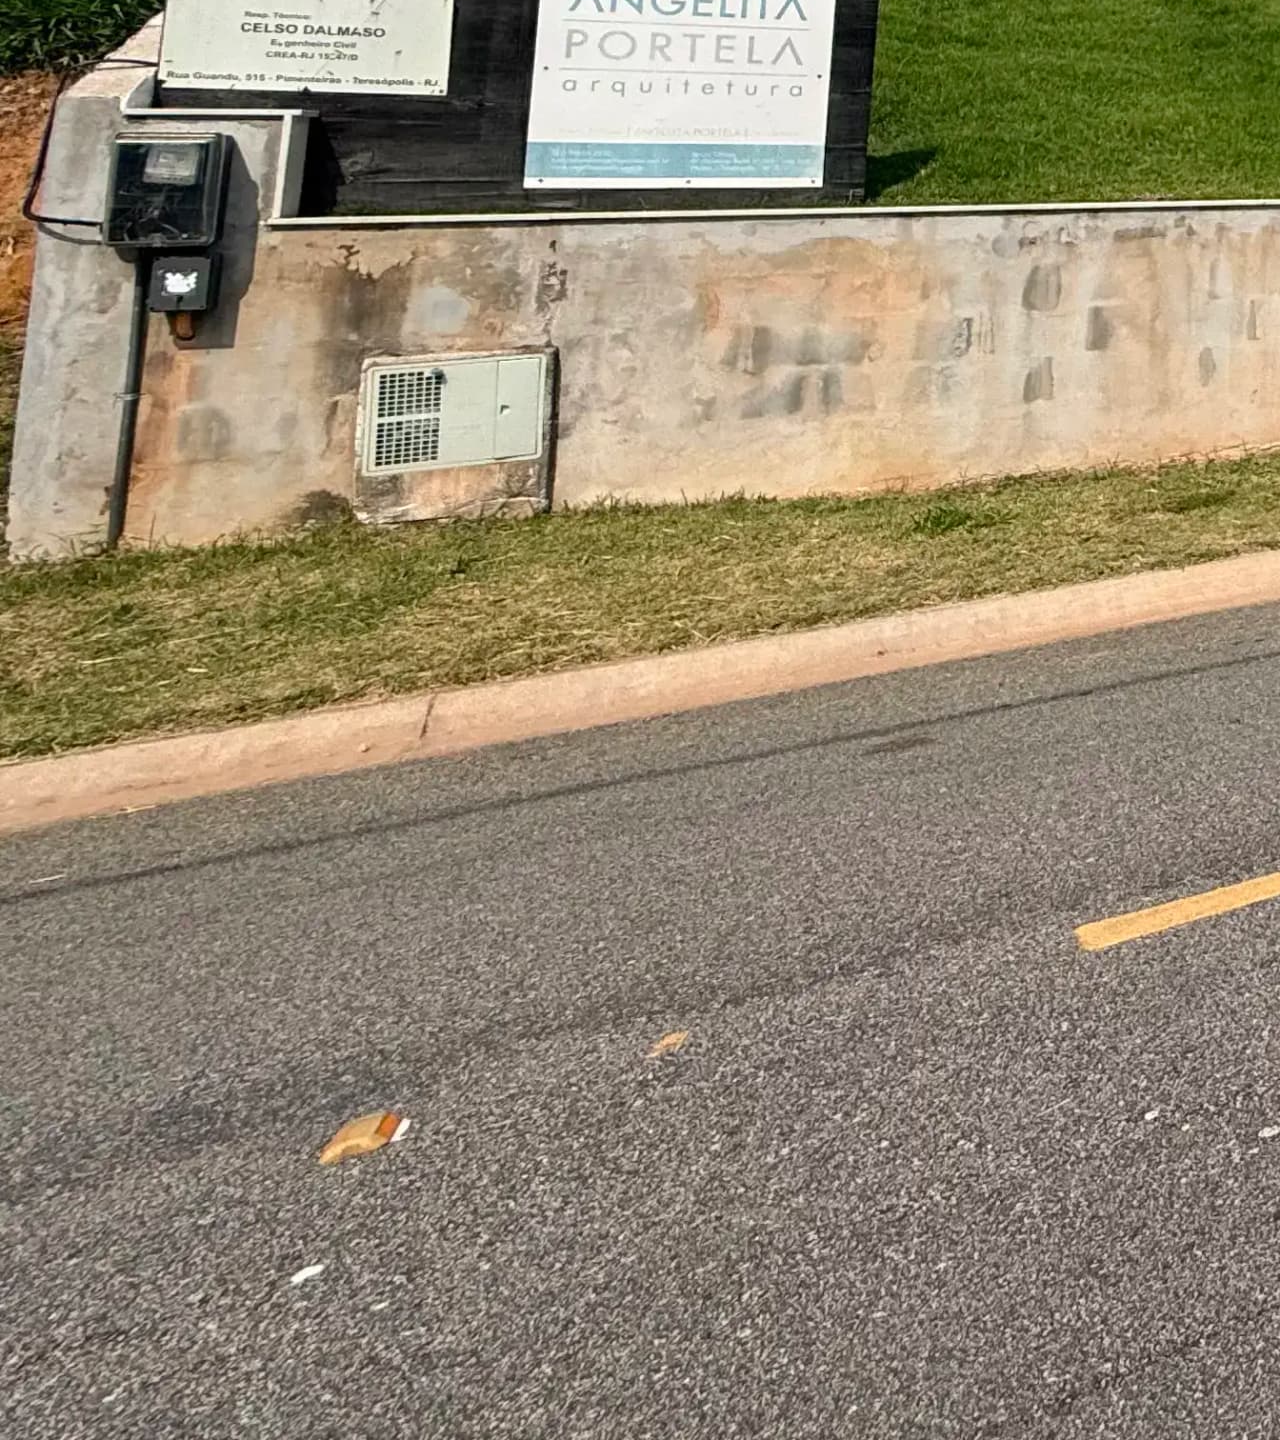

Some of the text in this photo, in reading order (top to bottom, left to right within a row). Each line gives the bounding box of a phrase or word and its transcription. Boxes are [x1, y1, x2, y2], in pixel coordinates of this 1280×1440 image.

[241, 22, 386, 38] CELSO DALMASO
[333, 41, 357, 49] Civil
[565, 29, 804, 66] PORTELA
[265, 50, 314, 60] CREA-RJ
[166, 71, 190, 79] Rua
[562, 78, 803, 98] arquitetura
